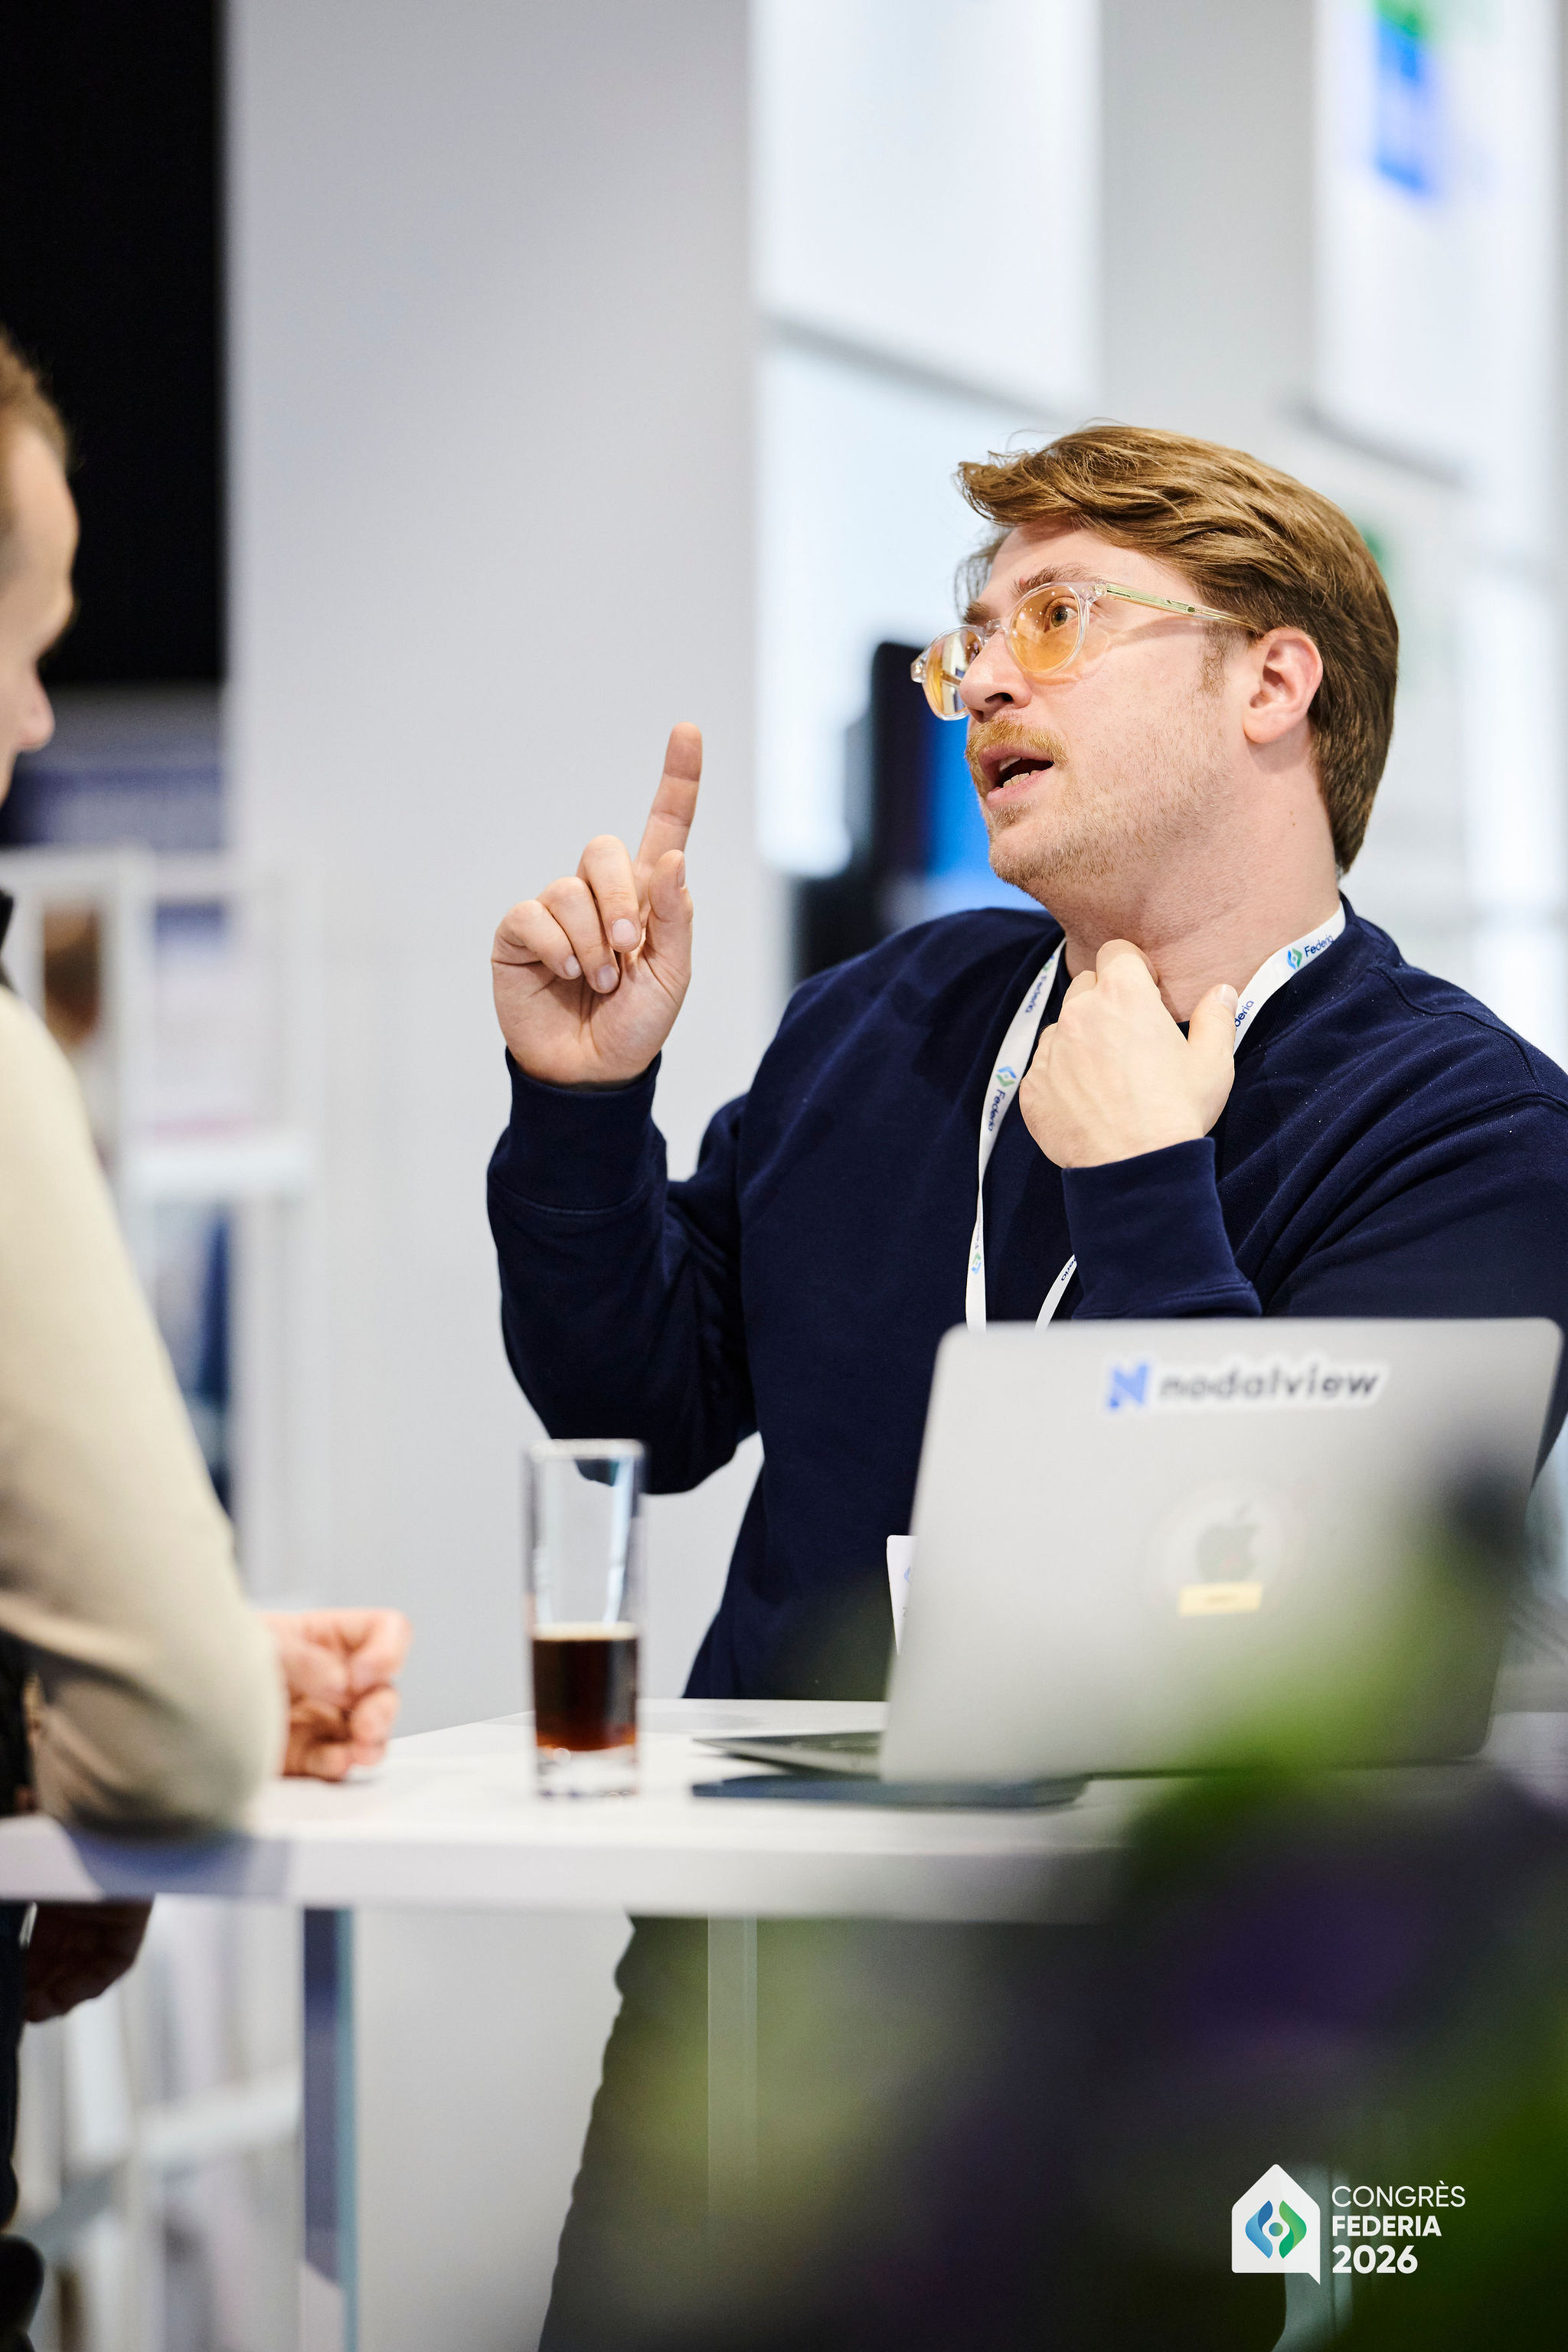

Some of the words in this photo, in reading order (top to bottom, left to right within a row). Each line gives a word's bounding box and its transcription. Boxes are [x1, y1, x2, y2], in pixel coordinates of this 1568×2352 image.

[1234, 1000, 1255, 1027] deria
[988, 1089, 1005, 1132] Federia
[1159, 1363, 1379, 1400] nodalview
